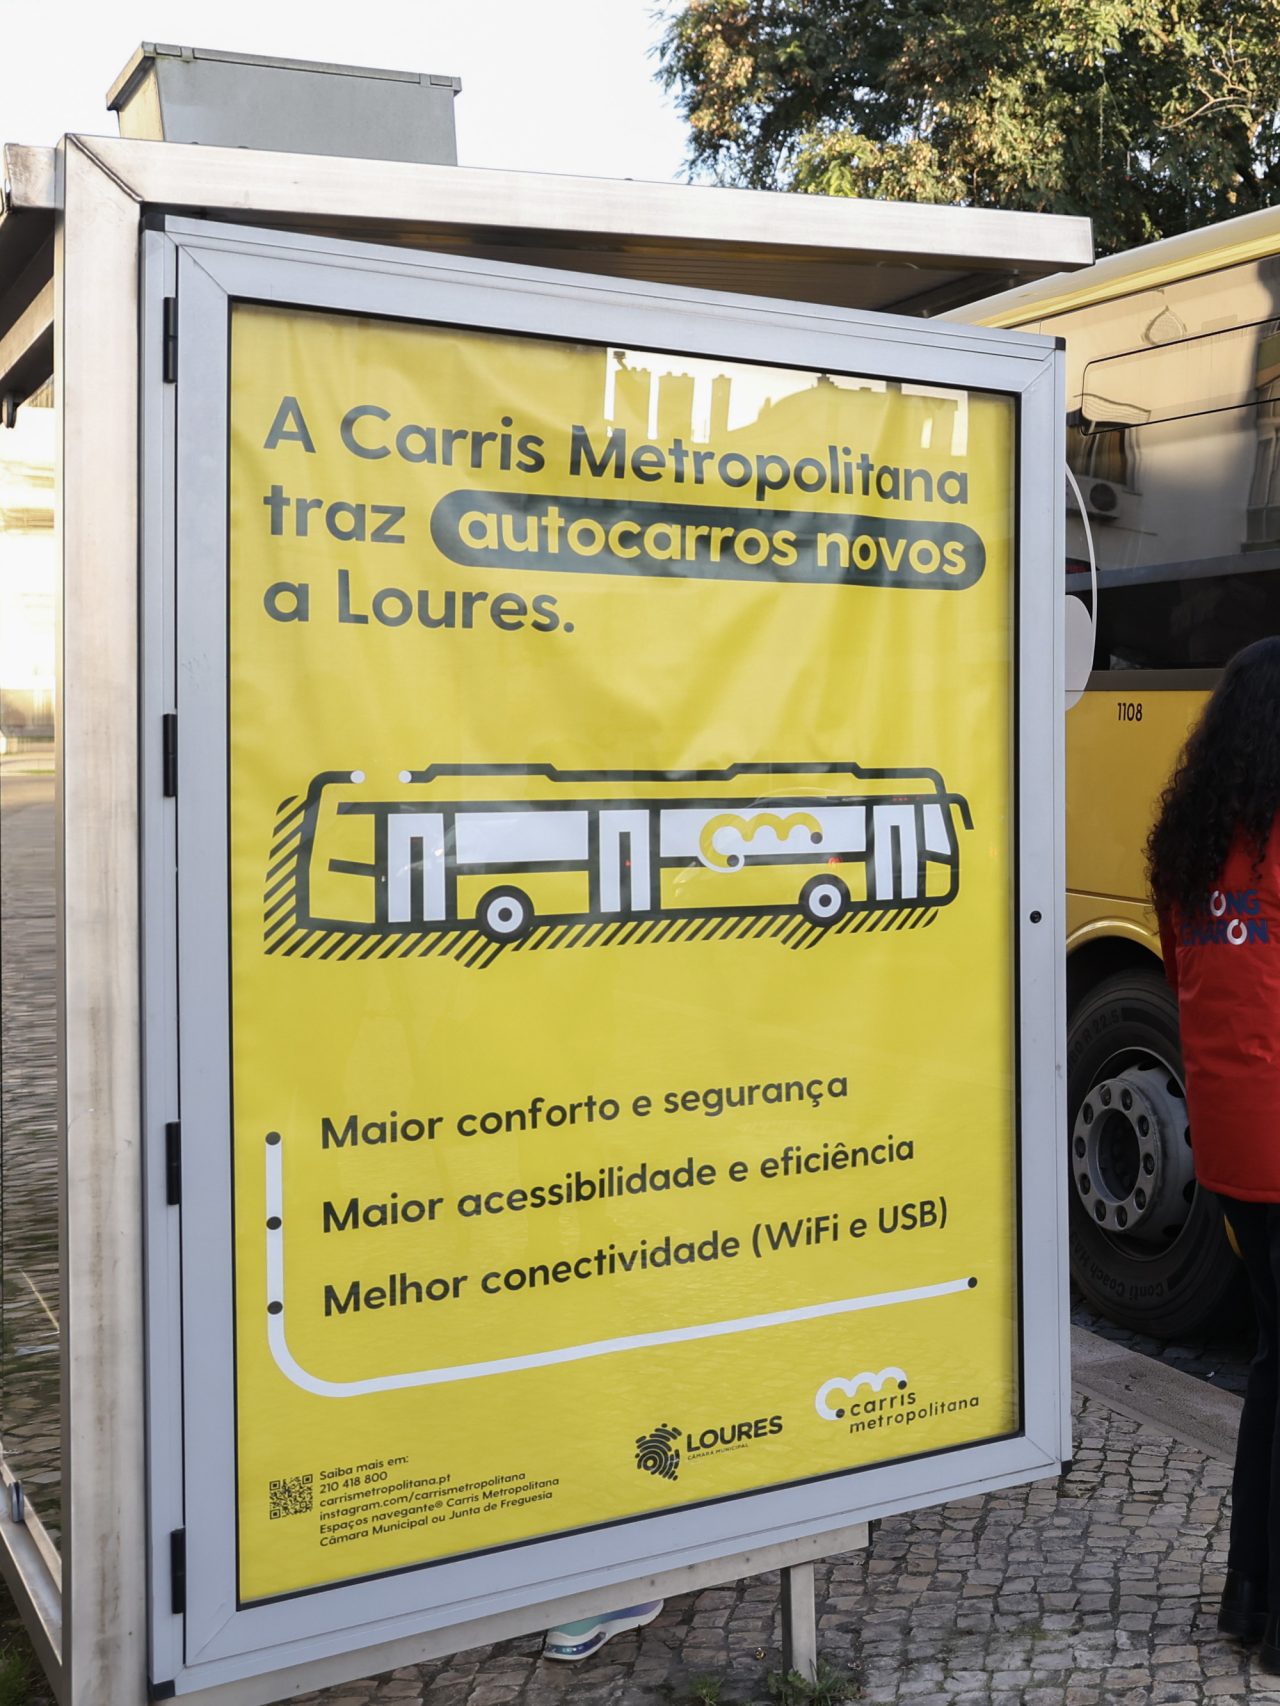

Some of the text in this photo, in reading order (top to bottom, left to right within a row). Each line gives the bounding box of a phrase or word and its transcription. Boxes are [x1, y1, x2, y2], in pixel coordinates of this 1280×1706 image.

[263, 395, 968, 504] A Carris Metropolitana
[263, 484, 966, 576] traz autocarros novos
[263, 568, 574, 634] a Loures.
[1117, 702, 1143, 721] 1108
[321, 1072, 849, 1149] Maior conforto e segurança
[323, 1134, 915, 1233] Maior acessibilidade e eficiência
[324, 1196, 948, 1316] Melhor conectividade (WiFi e USB)
[850, 1397, 979, 1434] metropolitana
[851, 1392, 916, 1417] carris
[687, 1415, 783, 1453] LOURES
[688, 1444, 748, 1460] CÂMARA MUNICIPAL
[320, 1456, 409, 1480] Saiba mais em:
[320, 1471, 388, 1494] 210 418 800
[320, 1474, 451, 1507] carrismetropolitana.pt
[320, 1472, 526, 1522] instagram.com/carrismetropolitana
[320, 1516, 368, 1534] Espaços
[446, 1494, 479, 1508] Carris
[482, 1477, 560, 1501] Metropolitana
[320, 1490, 552, 1547] Câmara Municipal ou Junta de Freguesia
